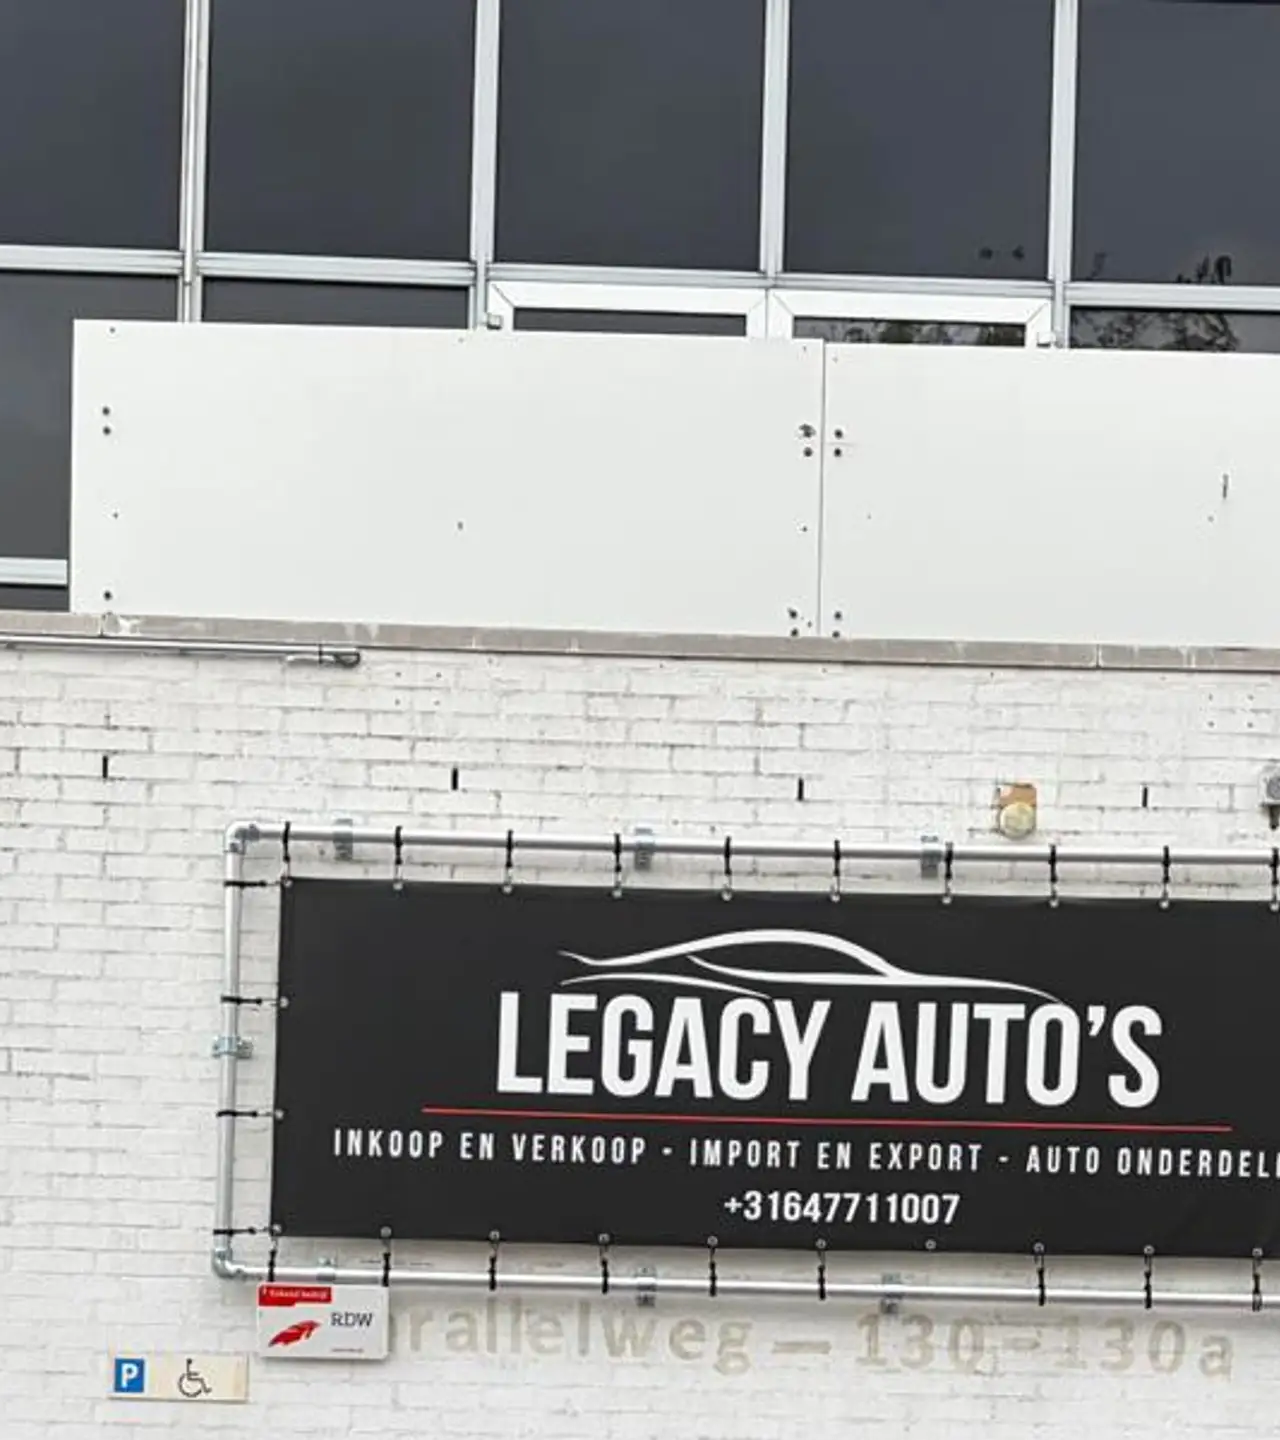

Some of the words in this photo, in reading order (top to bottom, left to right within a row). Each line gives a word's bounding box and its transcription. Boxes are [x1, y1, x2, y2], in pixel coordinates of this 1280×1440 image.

[496, 991, 831, 1101] LEGACY
[851, 1001, 1163, 1108] AUTO'S
[334, 1128, 443, 1159] INKOOP
[459, 1132, 494, 1161] EN
[511, 1133, 646, 1164] VERKOOP
[690, 1138, 801, 1168] IMPORT
[817, 1141, 851, 1170] EN
[869, 1142, 982, 1171] EXPORT
[1025, 1145, 1100, 1174] AUTO
[723, 1190, 961, 1225] +31647711007
[330, 1311, 373, 1327] RDW
[389, 1299, 754, 1375] rallelweg
[121, 1363, 139, 1388] P
